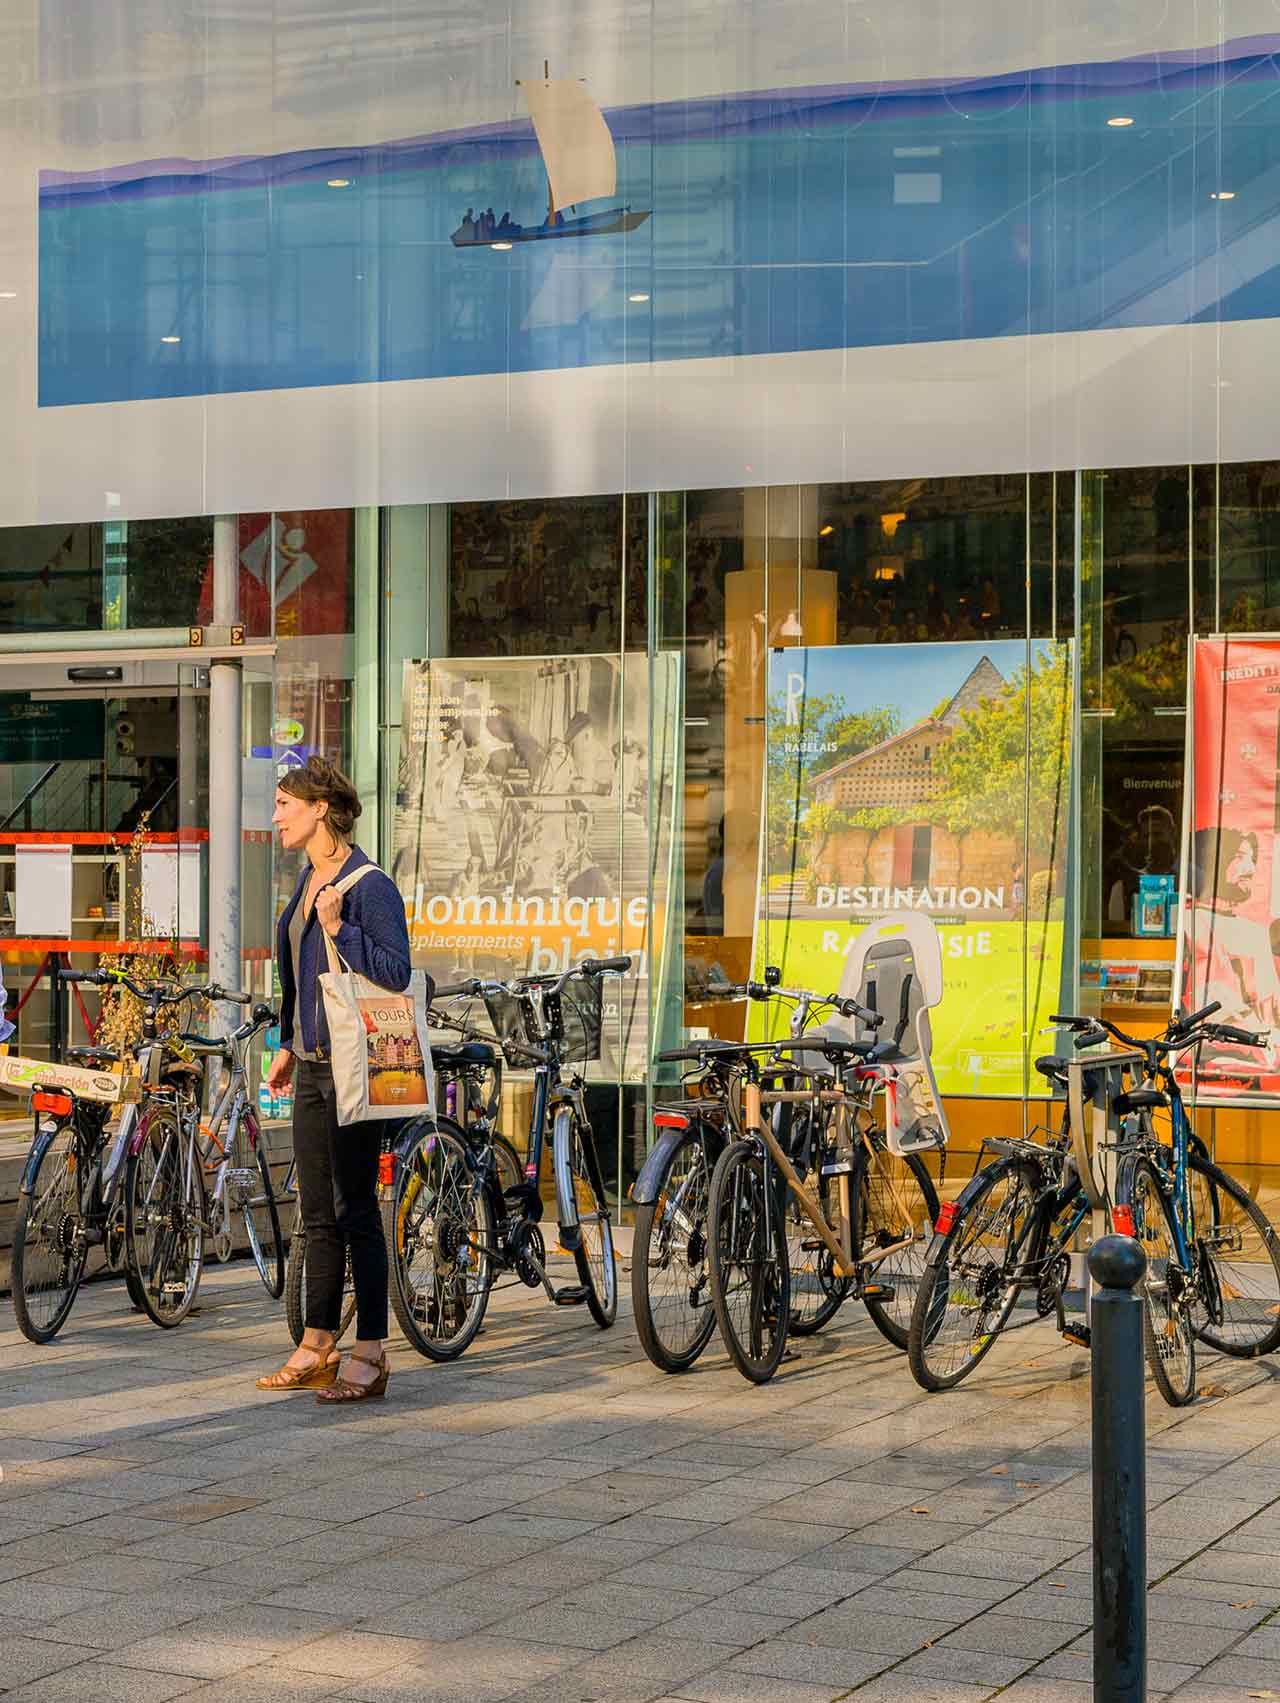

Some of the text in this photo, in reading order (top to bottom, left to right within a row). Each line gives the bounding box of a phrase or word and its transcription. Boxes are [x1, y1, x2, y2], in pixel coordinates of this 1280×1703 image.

[816, 886, 1005, 910] DESTINATION
[405, 884, 654, 937] dominique
[408, 930, 525, 951] éplacements
[370, 1008, 414, 1022] TOURS
